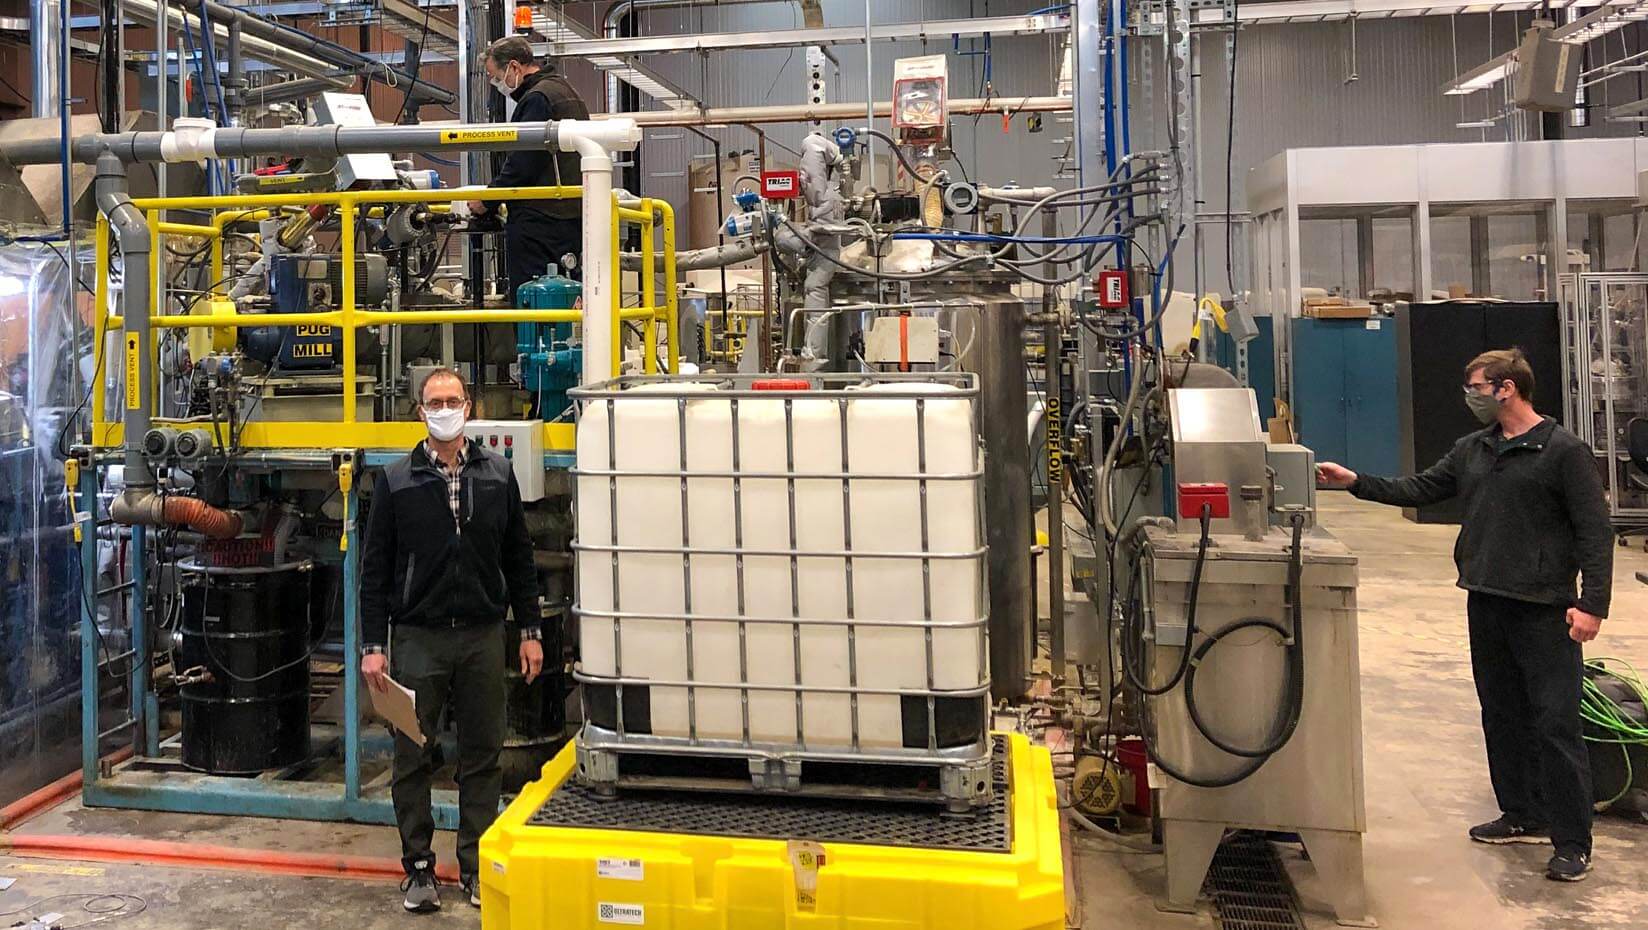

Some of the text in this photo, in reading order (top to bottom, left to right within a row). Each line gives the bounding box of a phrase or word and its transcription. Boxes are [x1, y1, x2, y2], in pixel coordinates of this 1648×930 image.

[298, 325, 330, 335] PUG
[294, 344, 332, 356] MILL
[1048, 398, 1060, 482] OVERFLOW
